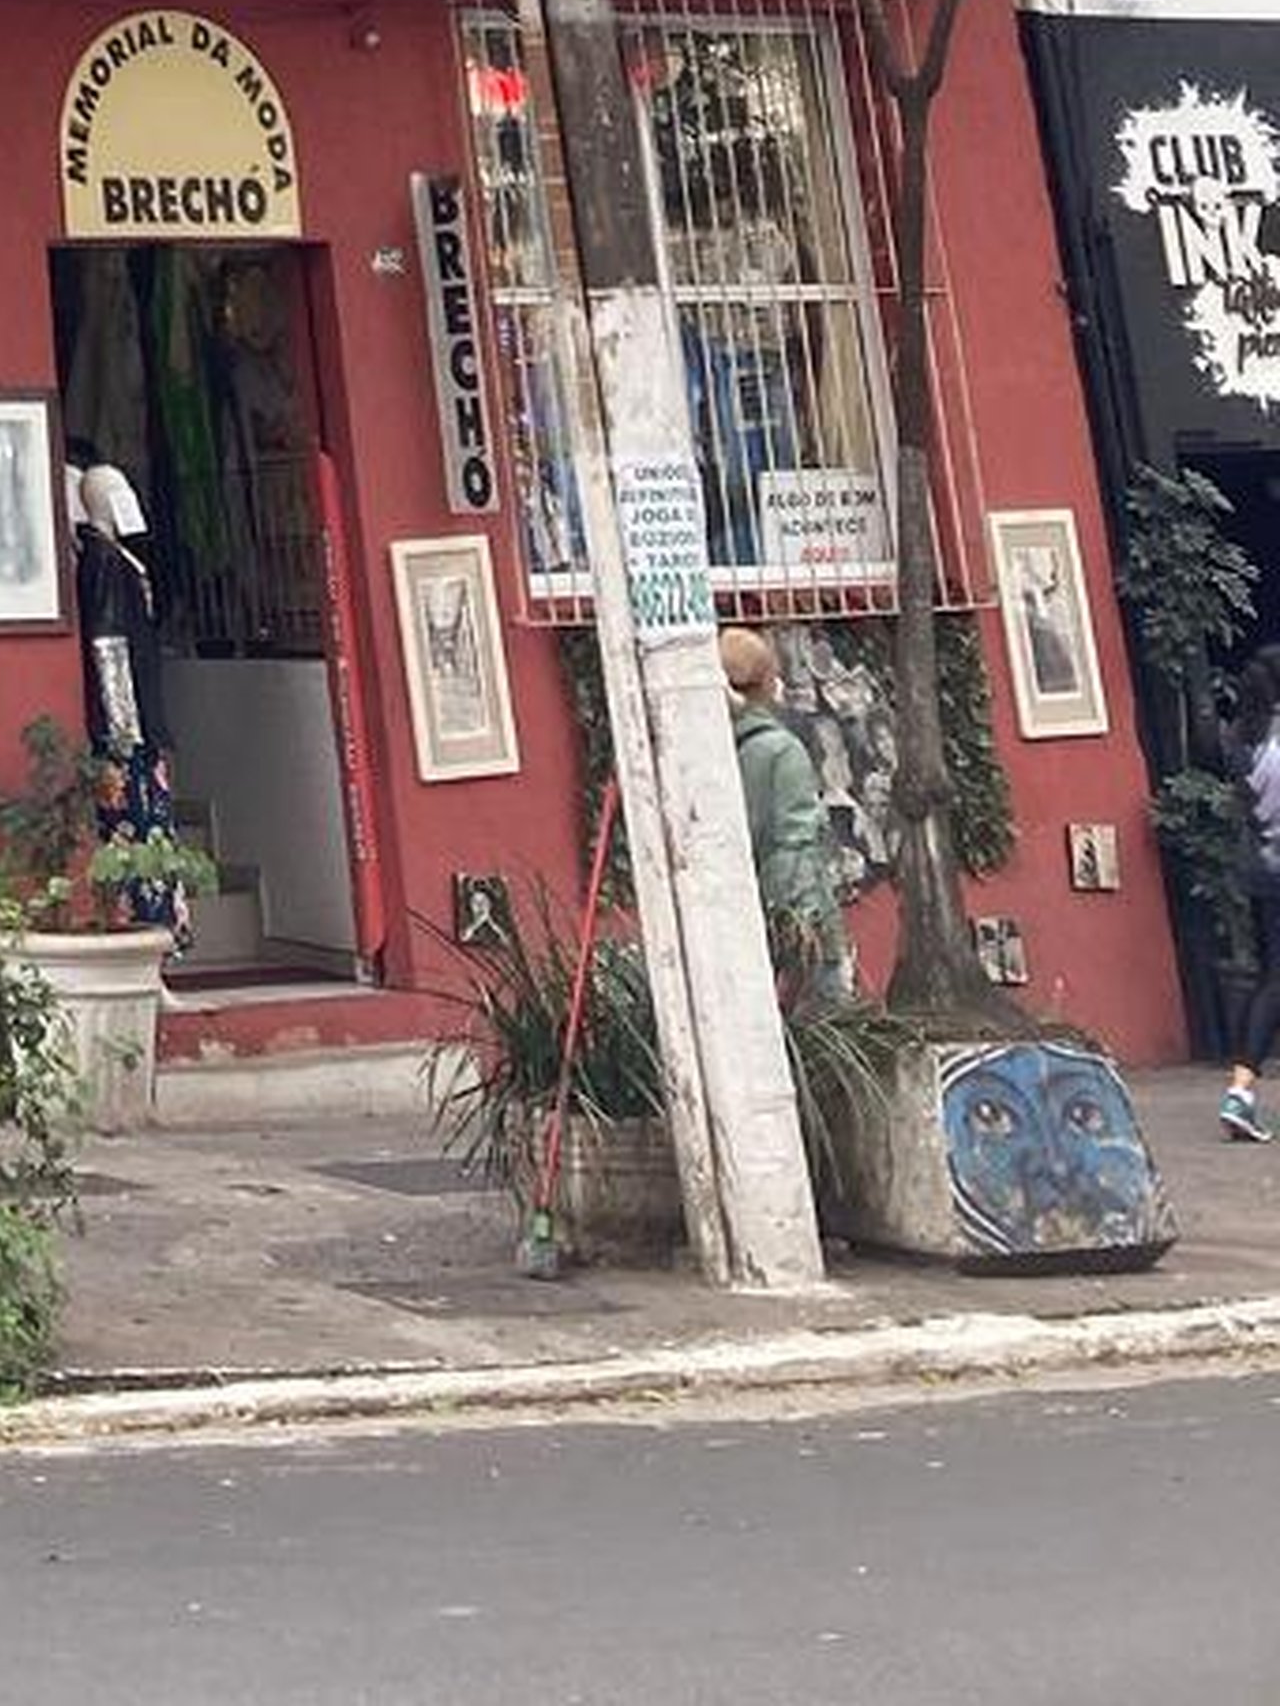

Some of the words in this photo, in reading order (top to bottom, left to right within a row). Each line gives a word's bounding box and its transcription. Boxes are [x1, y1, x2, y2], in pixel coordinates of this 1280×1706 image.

[66, 16, 175, 187] MEMORIAL
[191, 21, 230, 69] DA
[235, 66, 292, 193] MODA
[101, 163, 268, 225] BRECHÓ
[1149, 133, 1247, 186] CLUB
[1147, 189, 1266, 290] INK
